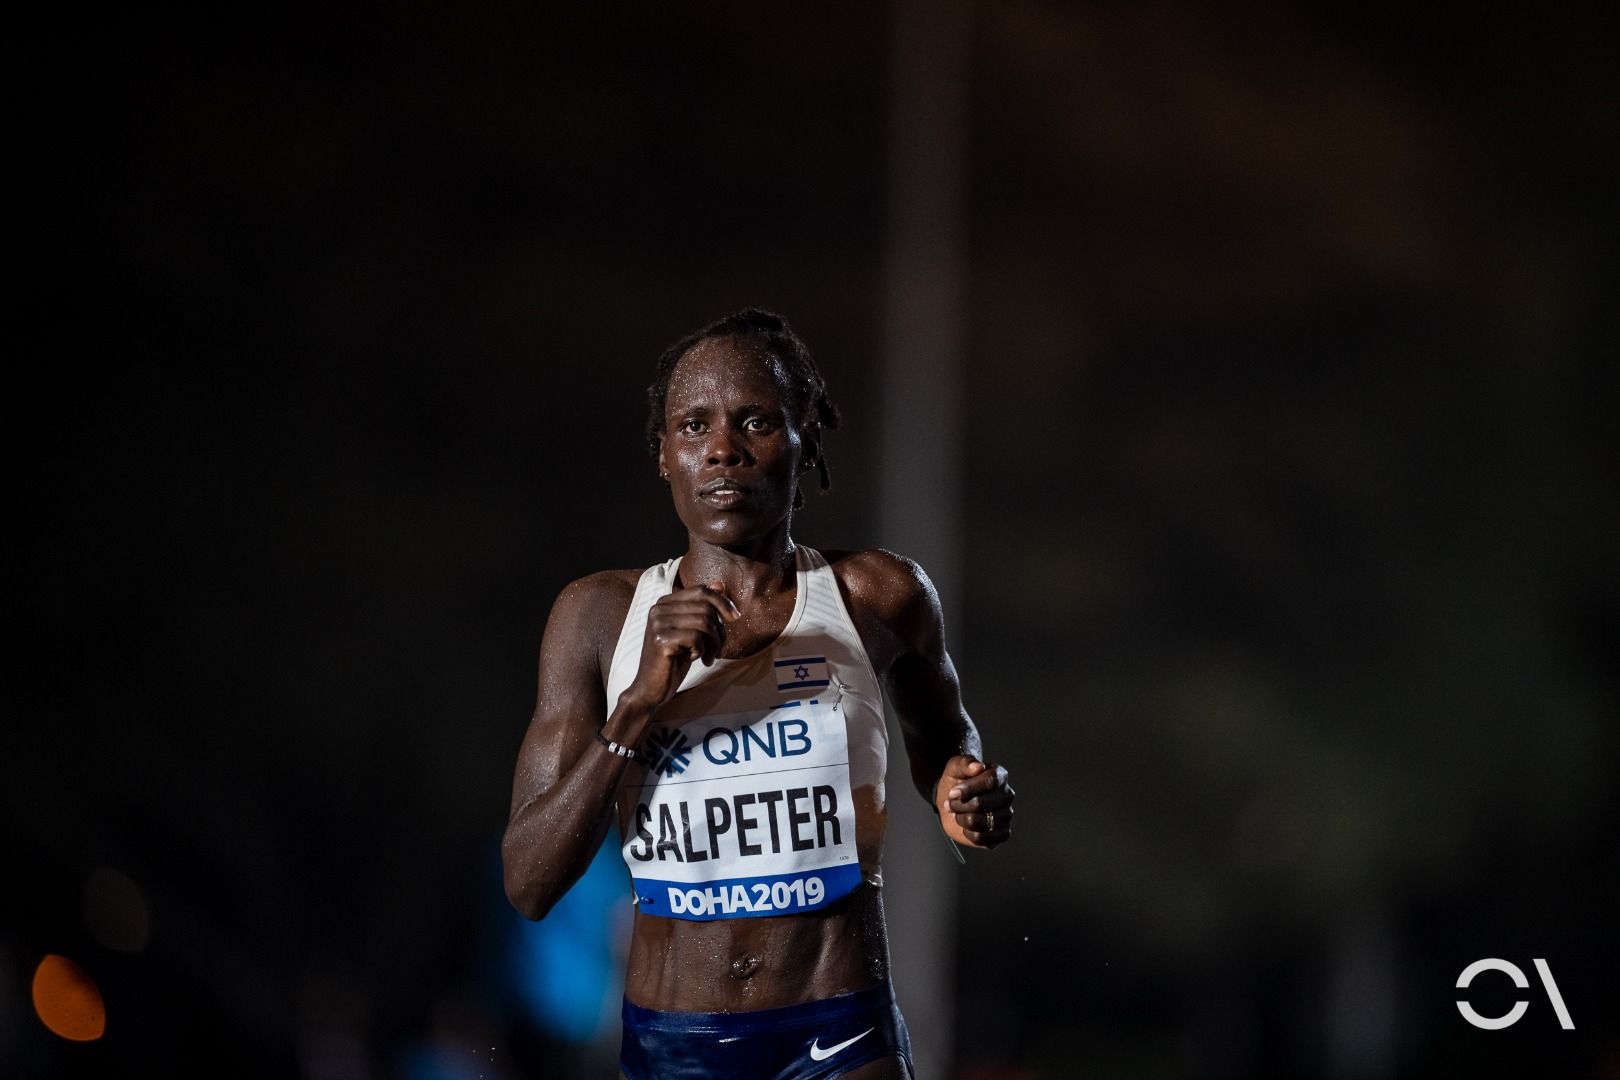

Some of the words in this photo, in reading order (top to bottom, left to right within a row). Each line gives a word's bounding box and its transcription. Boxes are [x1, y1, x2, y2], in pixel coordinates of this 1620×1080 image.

[702, 719, 812, 765] QNB
[630, 785, 842, 863] SALPETER
[667, 876, 825, 916] DOHA2019
